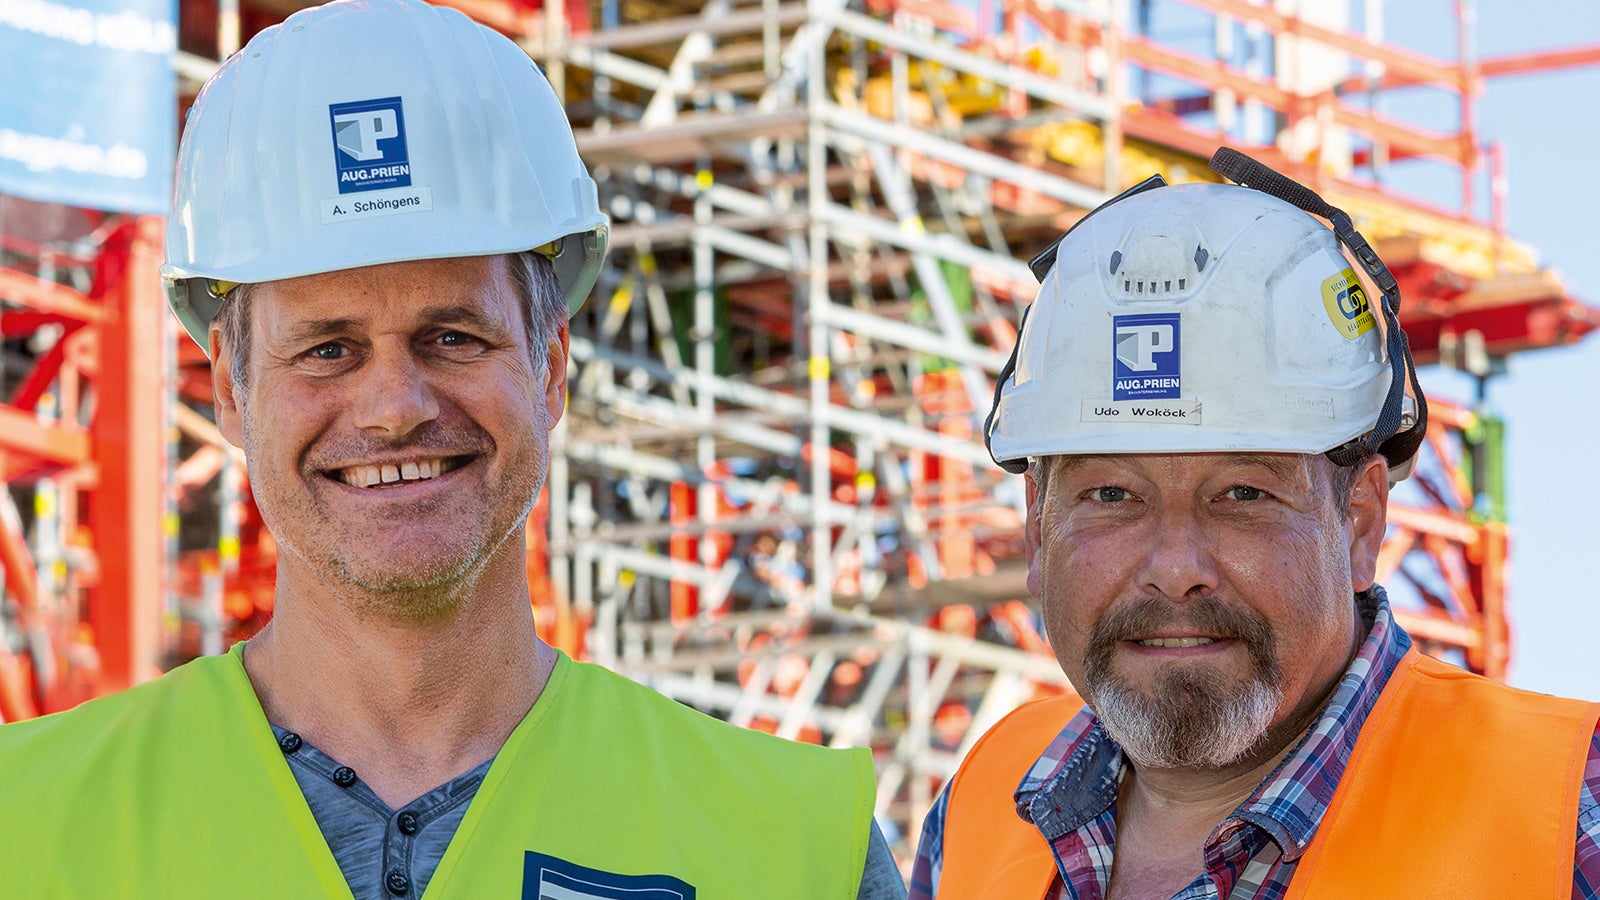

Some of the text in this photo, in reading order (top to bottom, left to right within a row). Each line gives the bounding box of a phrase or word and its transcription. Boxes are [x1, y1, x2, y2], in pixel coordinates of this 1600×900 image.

[341, 164, 410, 183] AUG.PRIEN
[332, 196, 421, 216] A. Schöngens
[1116, 378, 1180, 391] AUG.PRIEN
[1094, 407, 1187, 418] Udo Woköck
